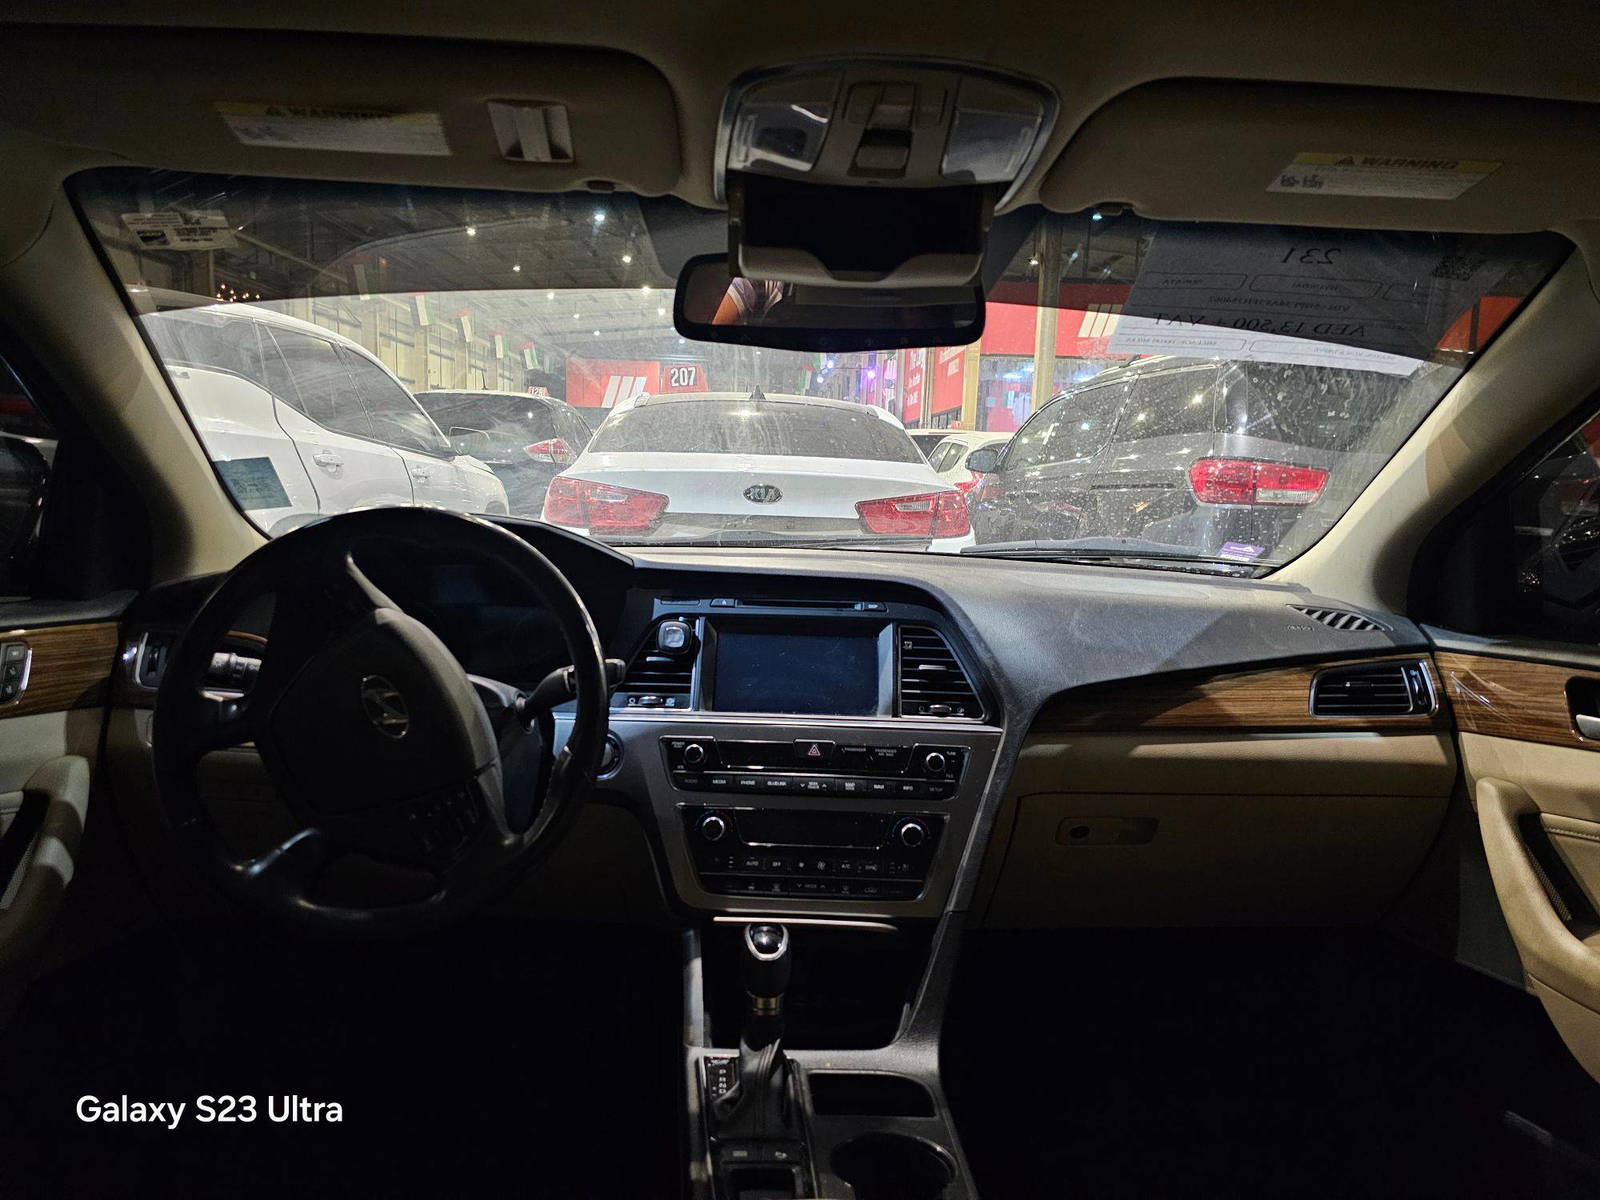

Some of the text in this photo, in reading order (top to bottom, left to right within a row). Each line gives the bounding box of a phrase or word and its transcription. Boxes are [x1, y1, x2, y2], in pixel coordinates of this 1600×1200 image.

[1362, 156, 1459, 169] WARNING
[670, 366, 696, 387] 207
[744, 486, 781, 503] KIA
